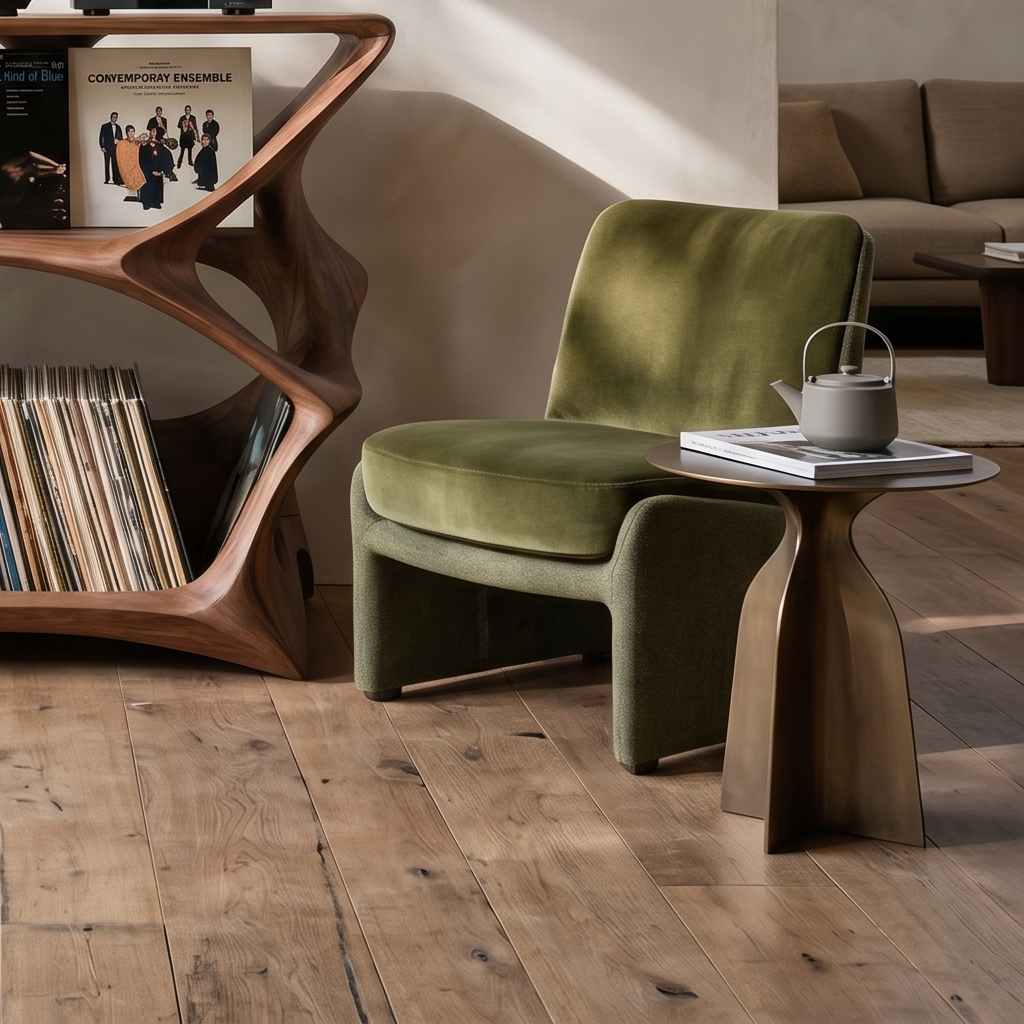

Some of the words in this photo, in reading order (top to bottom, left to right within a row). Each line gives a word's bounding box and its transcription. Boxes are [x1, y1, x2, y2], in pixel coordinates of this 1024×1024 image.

[28, 70, 38, 82] of
[41, 69, 64, 82] Blue
[173, 73, 232, 83] ENSEMBLE
